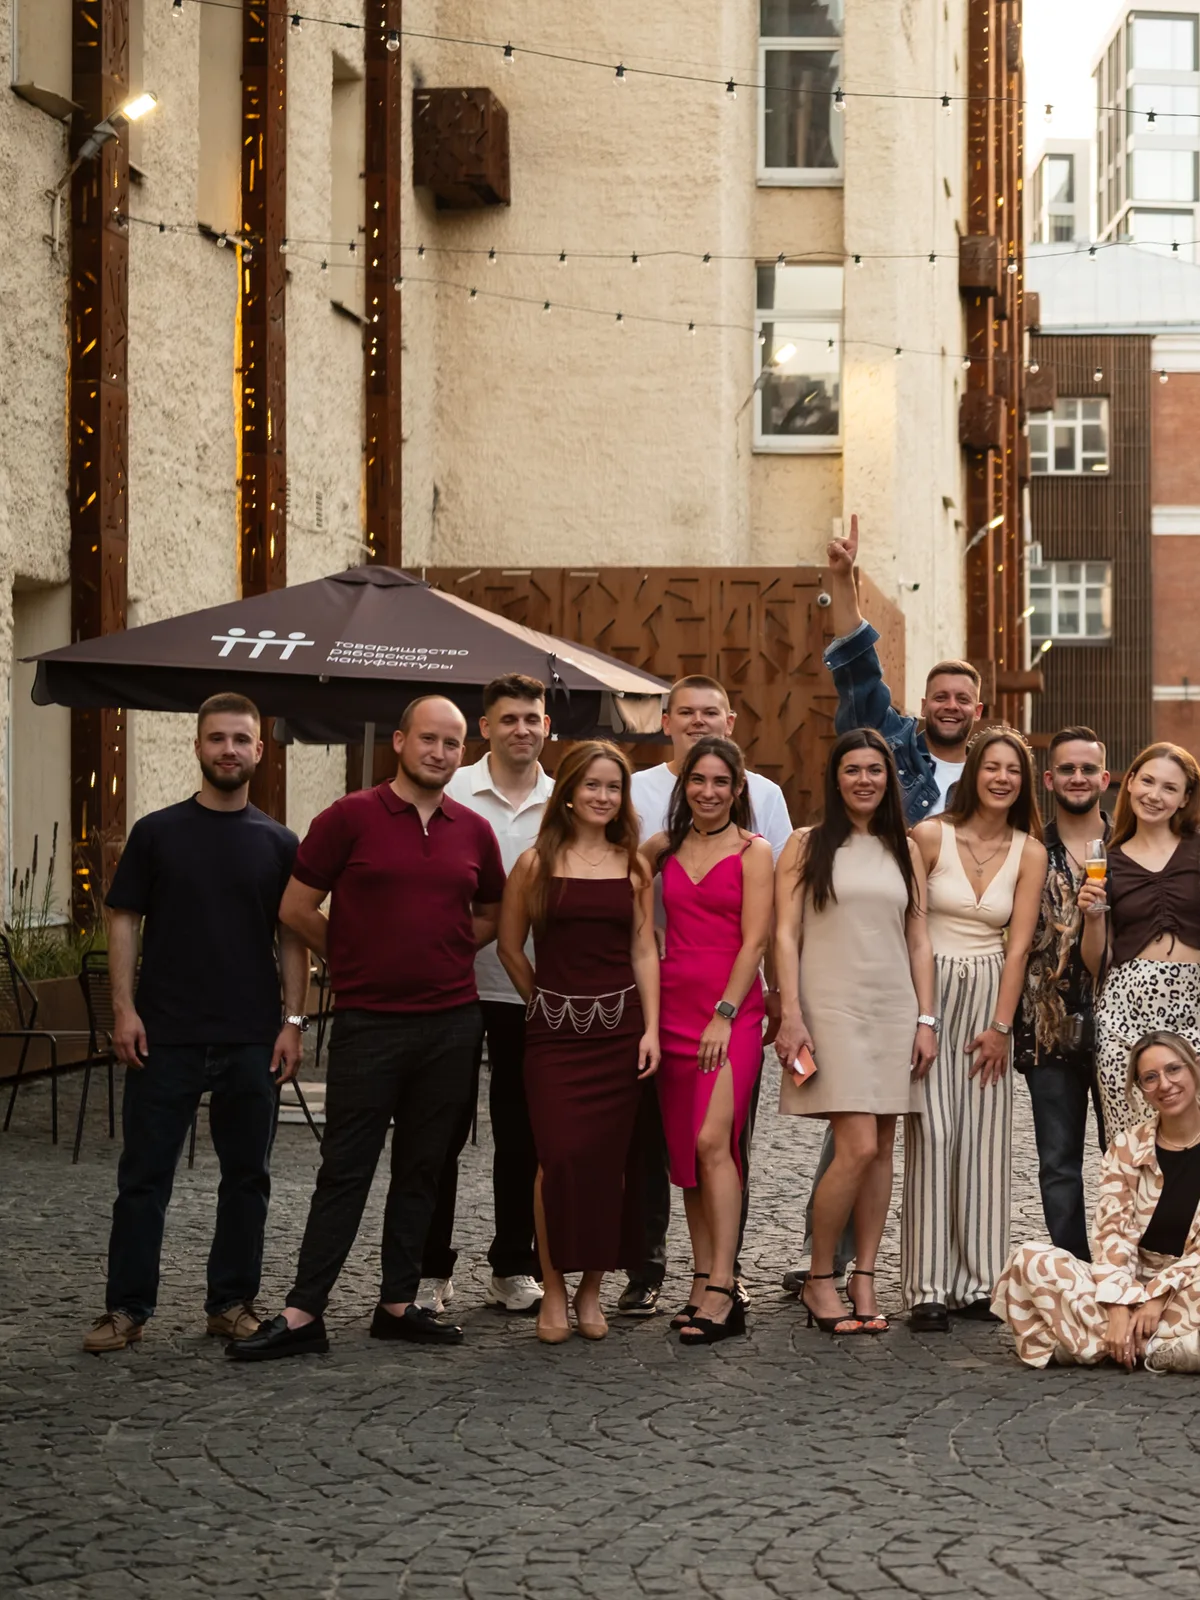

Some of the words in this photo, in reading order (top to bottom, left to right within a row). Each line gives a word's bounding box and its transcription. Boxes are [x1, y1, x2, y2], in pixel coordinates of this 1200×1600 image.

[329, 648, 428, 661] рябовской
[335, 641, 469, 656] товарищество
[326, 656, 454, 670] мануфактуры
